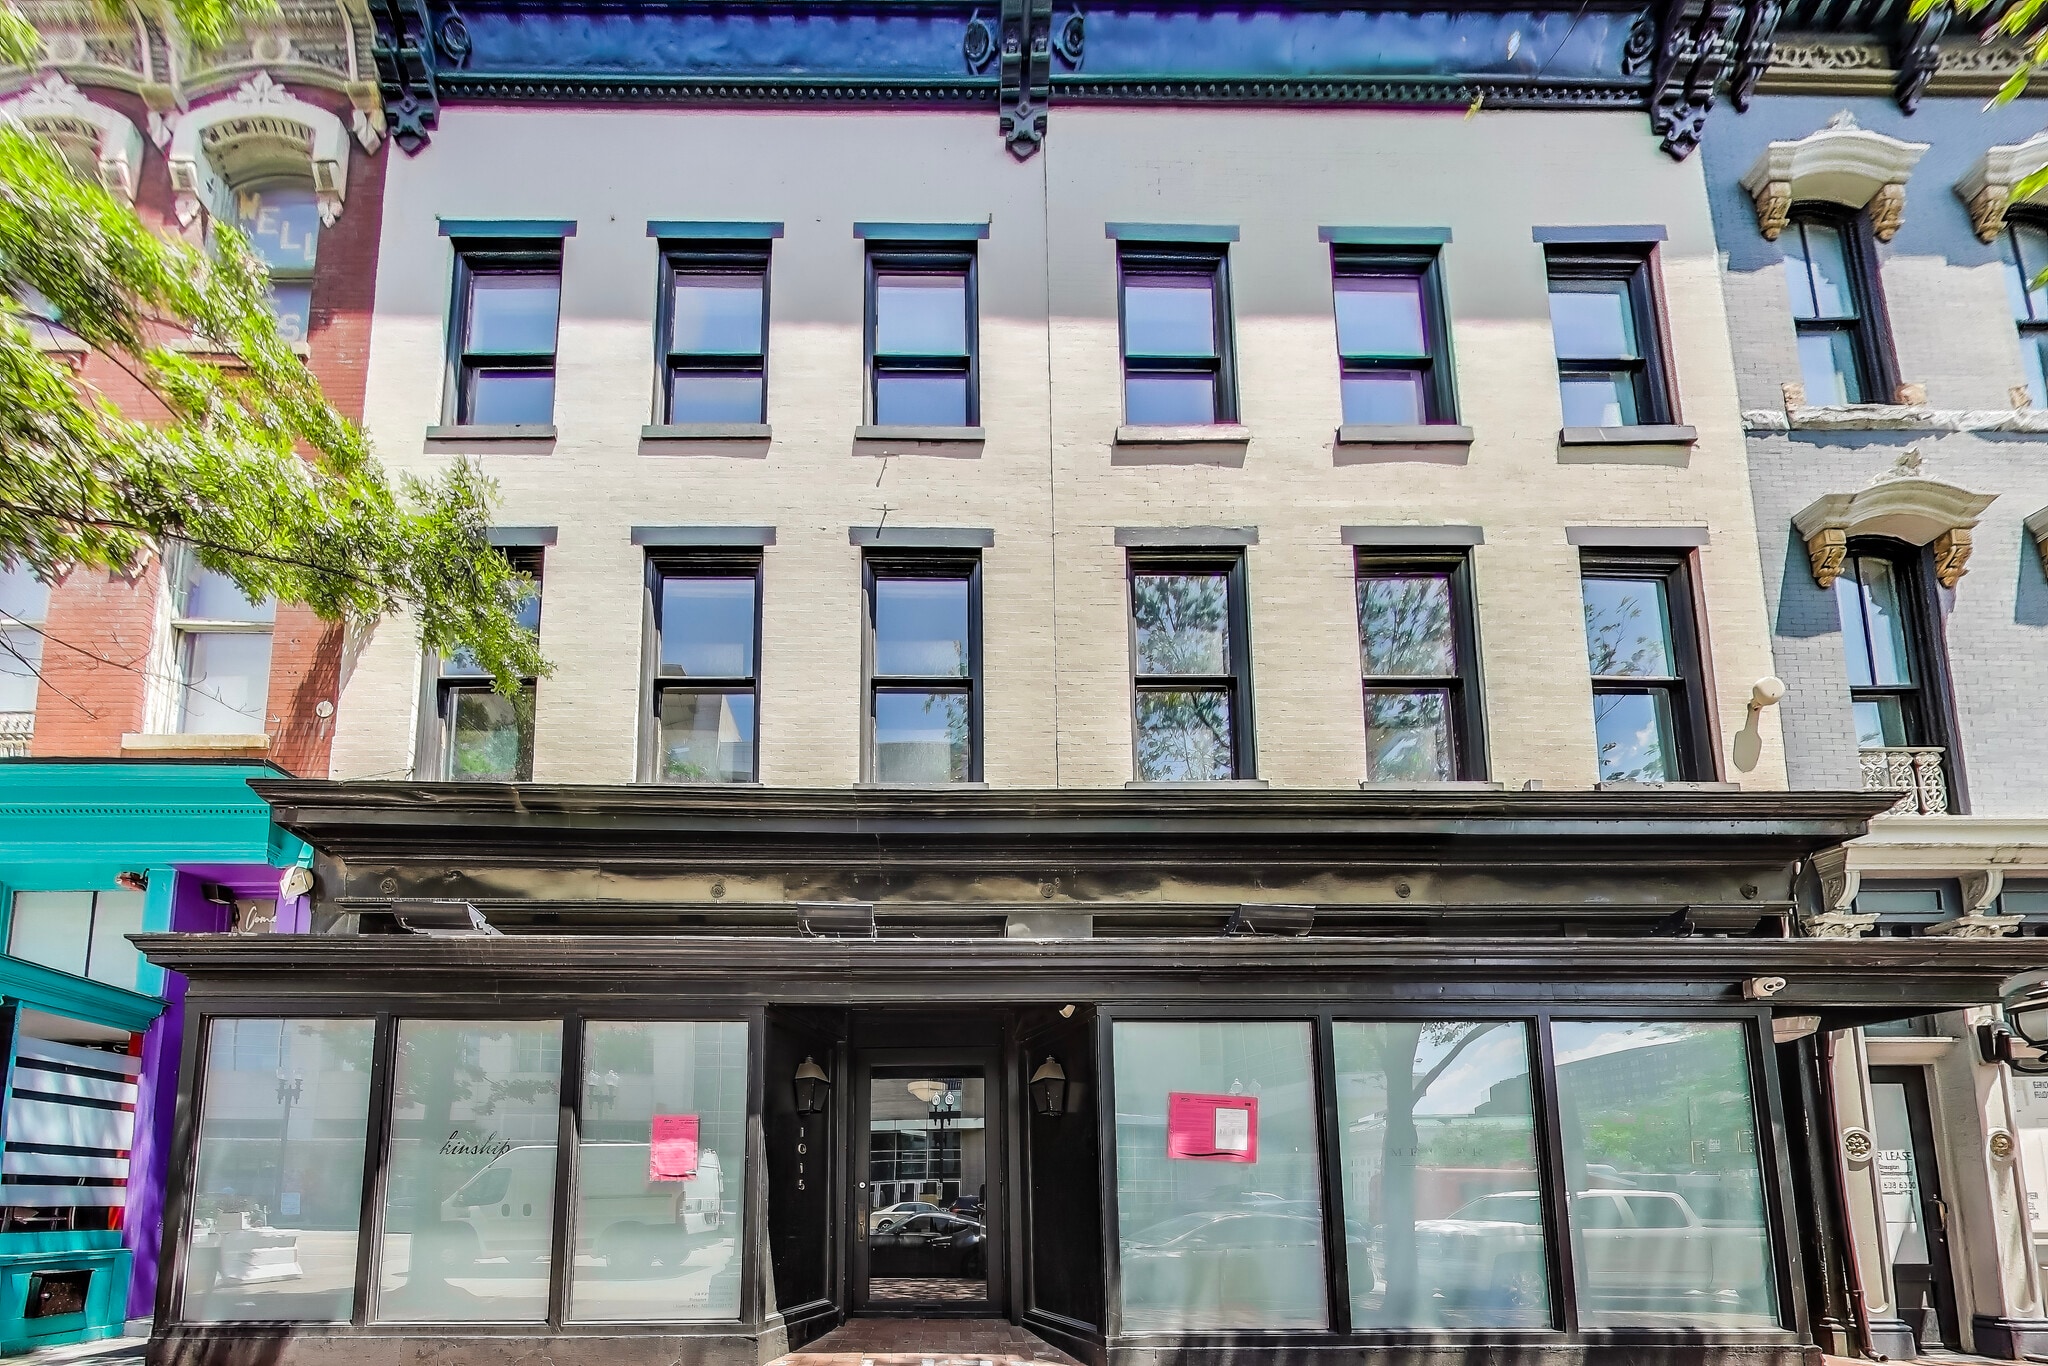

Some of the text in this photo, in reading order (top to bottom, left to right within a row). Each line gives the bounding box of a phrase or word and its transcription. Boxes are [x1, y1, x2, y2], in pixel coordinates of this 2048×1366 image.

[439, 1130, 511, 1169] kinship
[797, 1126, 807, 1191] 1015
[1885, 1151, 1912, 1161] LEASE
